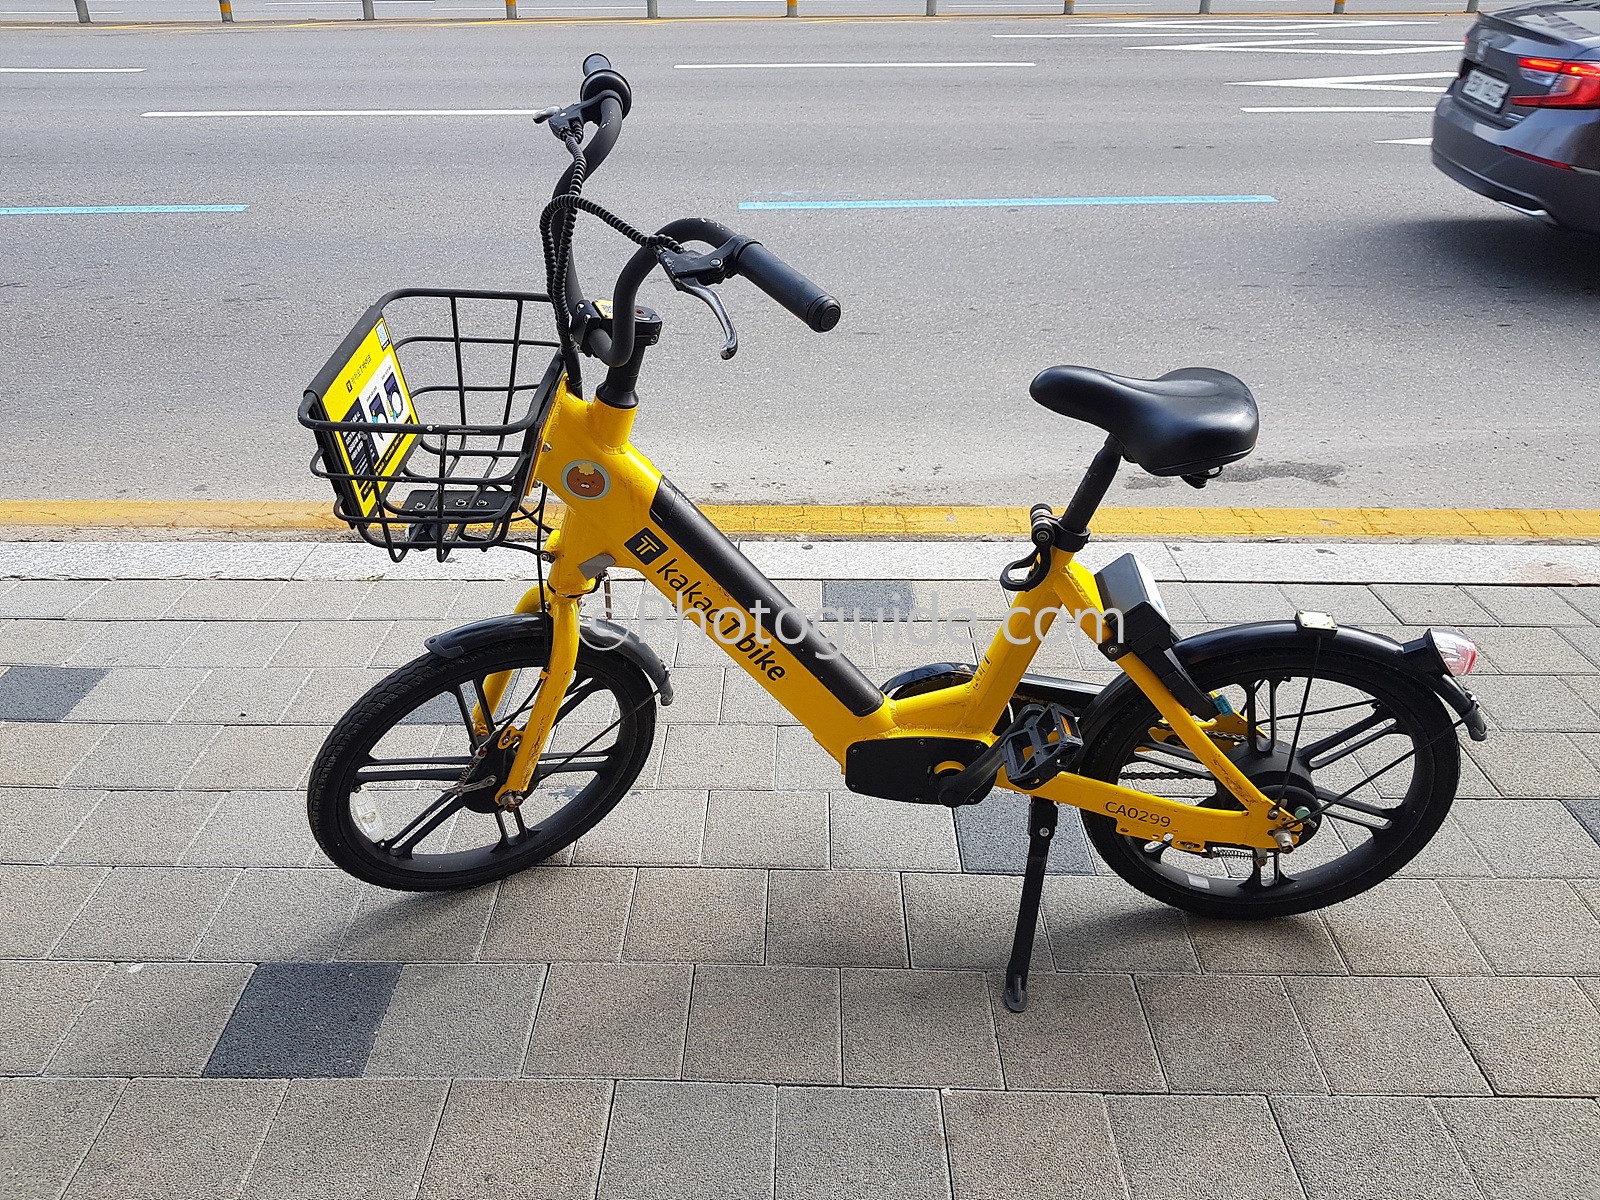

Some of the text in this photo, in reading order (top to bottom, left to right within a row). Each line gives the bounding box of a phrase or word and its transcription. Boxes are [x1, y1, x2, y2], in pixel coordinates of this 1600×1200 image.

[656, 558, 786, 682] kakao T bike
[1105, 801, 1171, 828] CA0299
